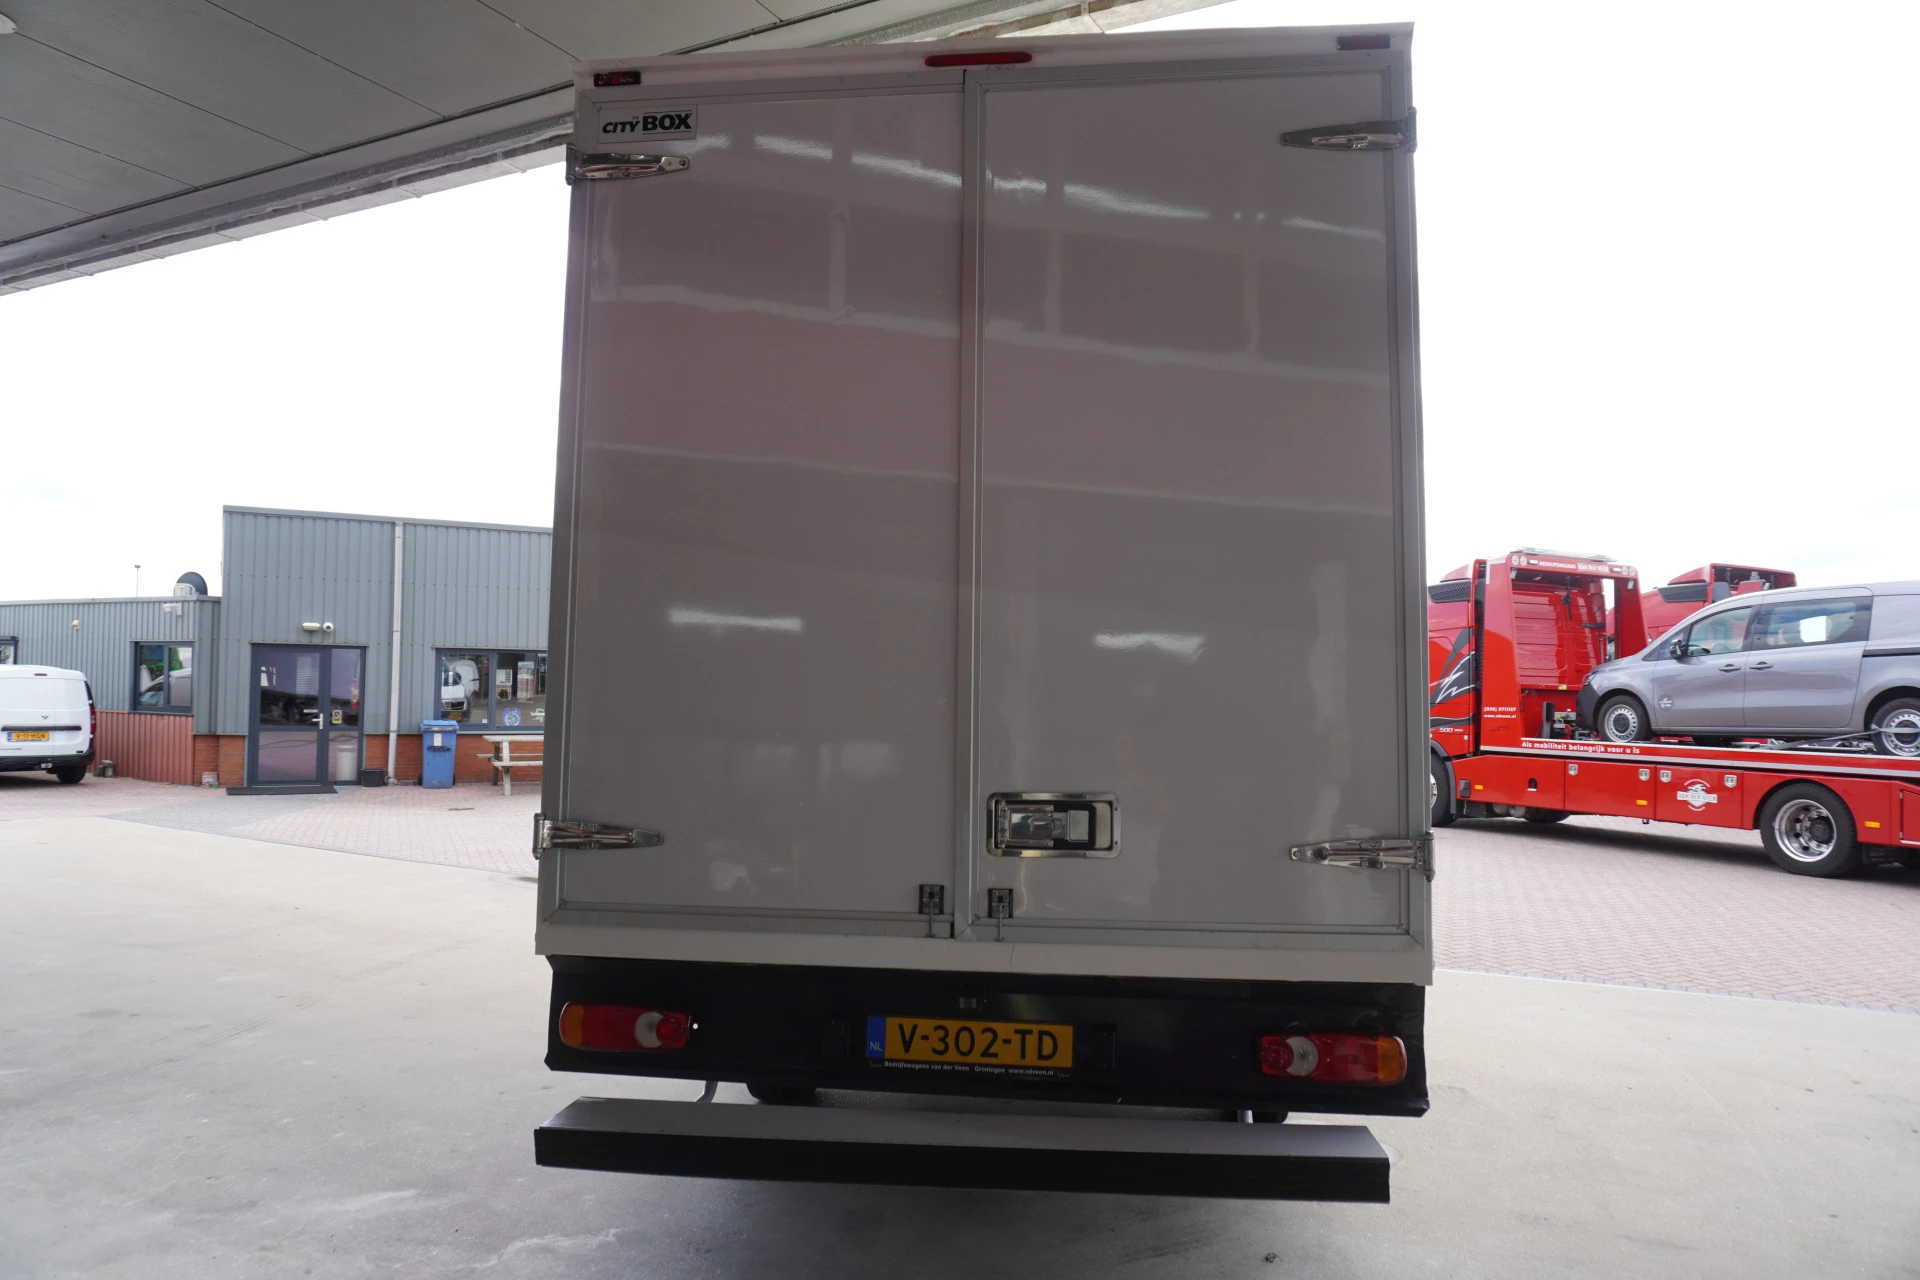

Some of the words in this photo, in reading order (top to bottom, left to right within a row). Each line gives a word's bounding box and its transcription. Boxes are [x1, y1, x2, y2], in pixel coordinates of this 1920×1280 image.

[602, 120, 640, 134] CITY
[642, 112, 693, 132] BOX
[1534, 742, 1567, 750] mobiliteit
[1569, 743, 1605, 753] belangrijk
[1633, 746, 1640, 754] is
[870, 1041, 883, 1052] NL
[898, 1023, 1058, 1061] V-302-TD
[884, 1061, 930, 1070] Bedrijfswagens
[974, 1066, 1006, 1074] Groningen
[1008, 1067, 1054, 1076] www.vdveen.nl
